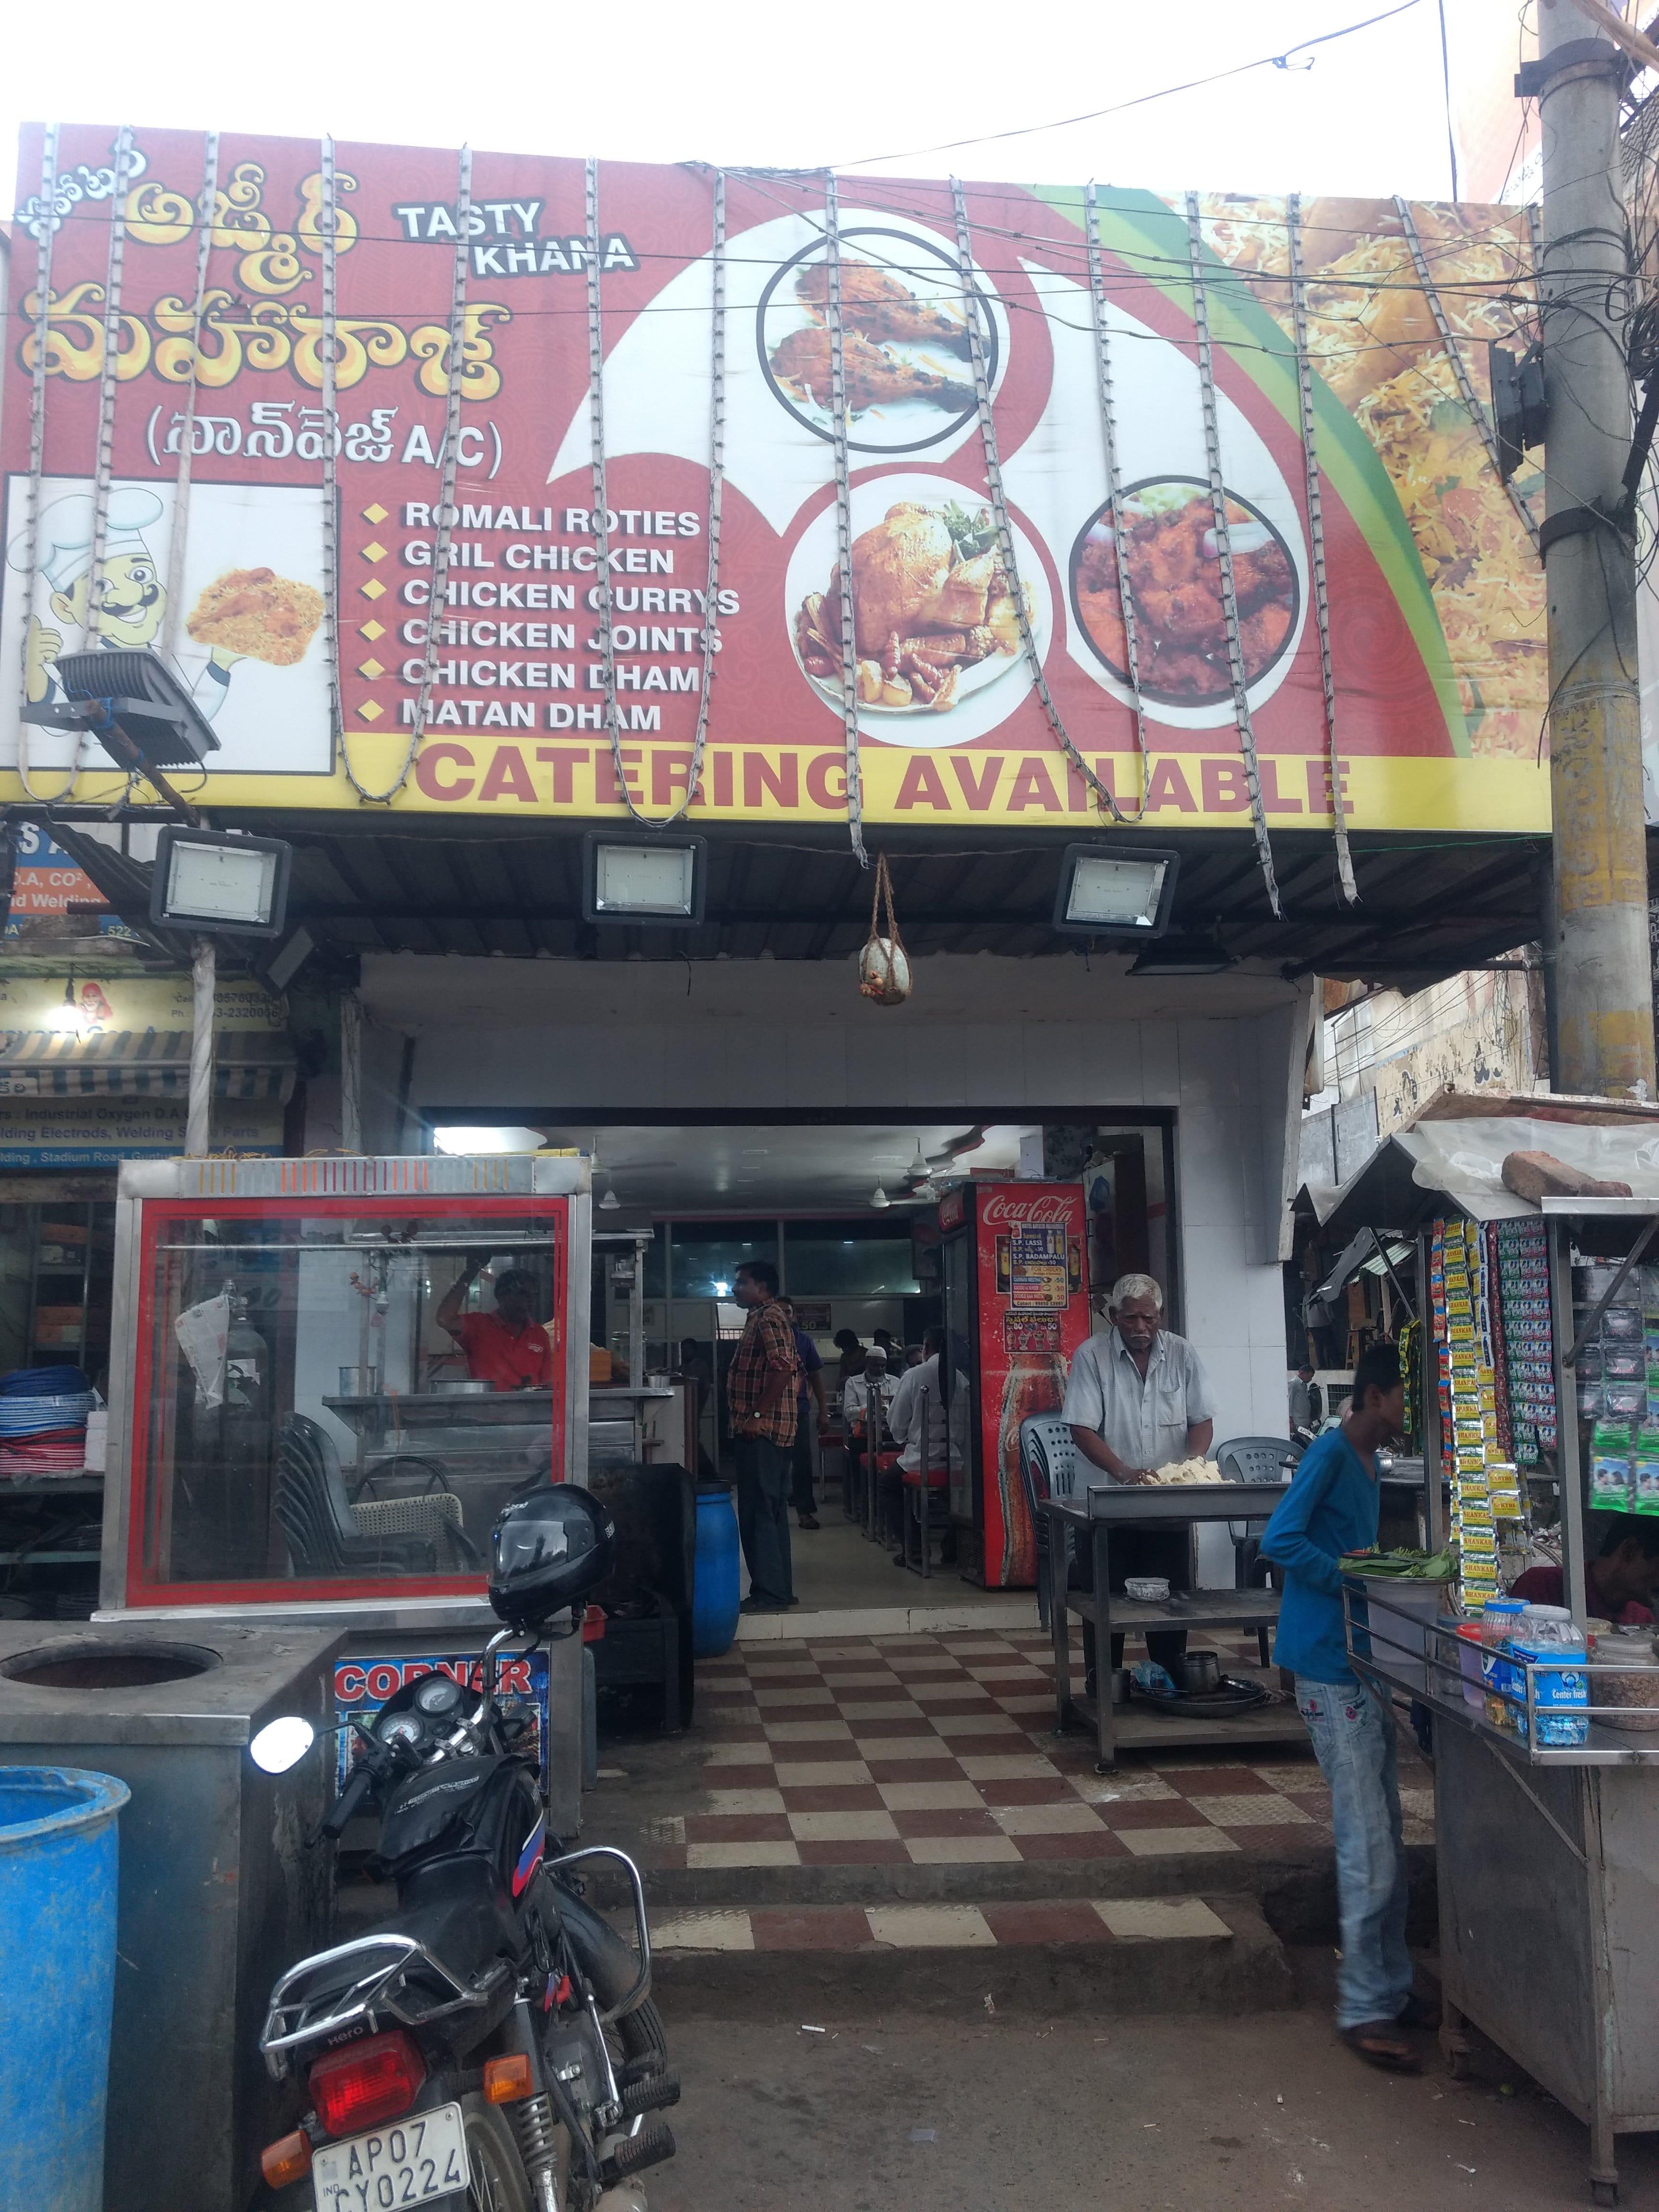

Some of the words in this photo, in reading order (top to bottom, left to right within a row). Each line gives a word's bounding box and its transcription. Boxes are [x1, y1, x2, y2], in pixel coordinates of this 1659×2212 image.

[397, 202, 540, 238] TASTY
[473, 238, 635, 275] KHANA
[405, 502, 552, 531] ROMALI
[566, 508, 700, 536] ROTIES
[405, 540, 494, 567] GRIL
[506, 544, 673, 573] CHICKEN
[404, 579, 575, 610] CHICKEN
[588, 587, 740, 615] CURRYS
[403, 619, 575, 648] CHICKEN
[402, 658, 575, 688] CHICKEN
[589, 664, 699, 692] DHAM
[402, 698, 535, 728] MATAN
[549, 703, 661, 731] DHAM
[414, 743, 863, 810] CATERING
[894, 755, 1354, 815] AVAILABLE
[25, 1108, 93, 1119] Industrial
[96, 1108, 150, 1122] Oxygen
[116, 1126, 173, 1139] Welding
[223, 1126, 259, 1138] Parts
[983, 1194, 1077, 1225] Coca-Cola
[1551, 1688, 1572, 1699] Center
[1573, 1689, 1587, 1699] fresh
[349, 2120, 428, 2180] AP07
[323, 2184, 339, 2197] IND
[335, 2148, 462, 2212] CY0224
